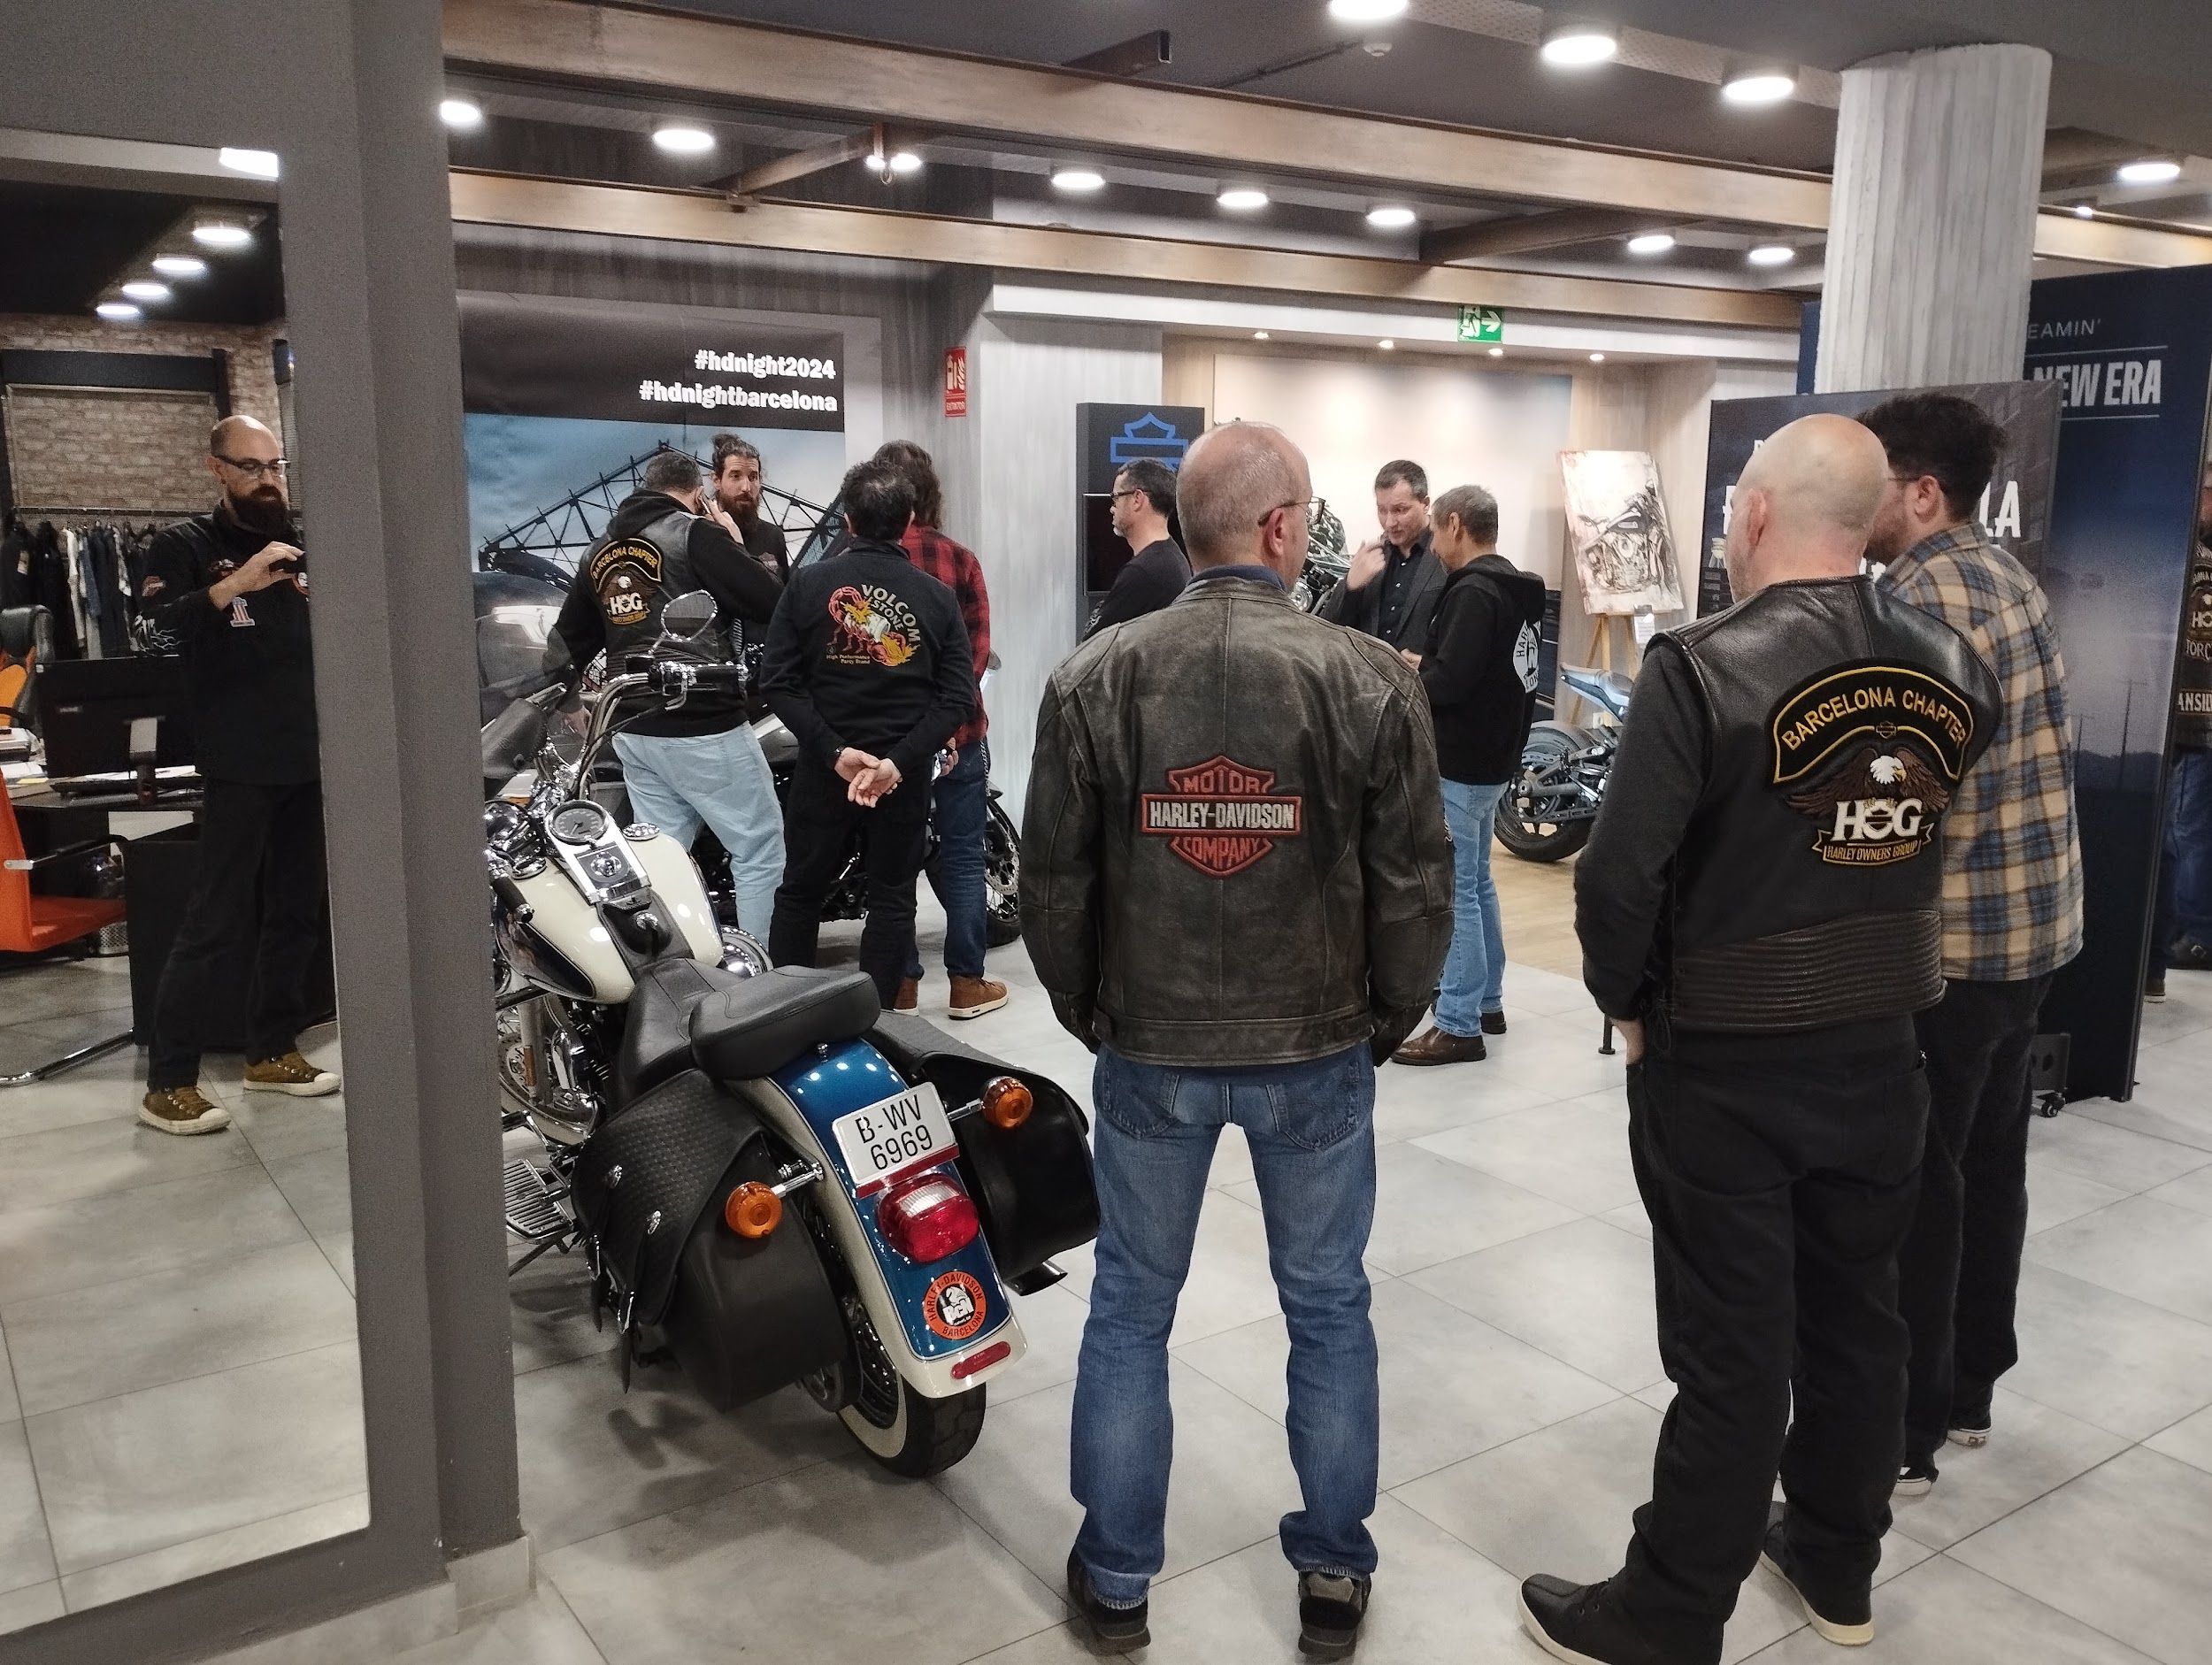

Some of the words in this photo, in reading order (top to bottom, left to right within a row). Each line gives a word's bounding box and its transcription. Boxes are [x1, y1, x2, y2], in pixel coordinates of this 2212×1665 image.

[695, 349, 836, 380] #hdnight2024
[639, 380, 838, 411] #hdnightbarcelona
[2104, 359, 2162, 406] ERA
[861, 584, 921, 642] VOLCOM
[870, 600, 903, 631] STONE
[1781, 686, 1896, 750] BARCELONA
[1902, 689, 1966, 749] CHAPTER
[1183, 764, 1260, 794] MOTOR
[1150, 802, 1294, 829] HARLEY-DAVIDSON
[1830, 797, 1924, 841] HOG
[1182, 836, 1262, 870] COMPANY
[1827, 845, 1856, 860] HARLEY
[1856, 847, 1892, 861] OWNERS
[855, 1093, 921, 1144] B-WV
[870, 1124, 933, 1170] 6969
[927, 1274, 983, 1321] HARLEY-DAVIDSON
[942, 1310, 984, 1337] BARCELONA
